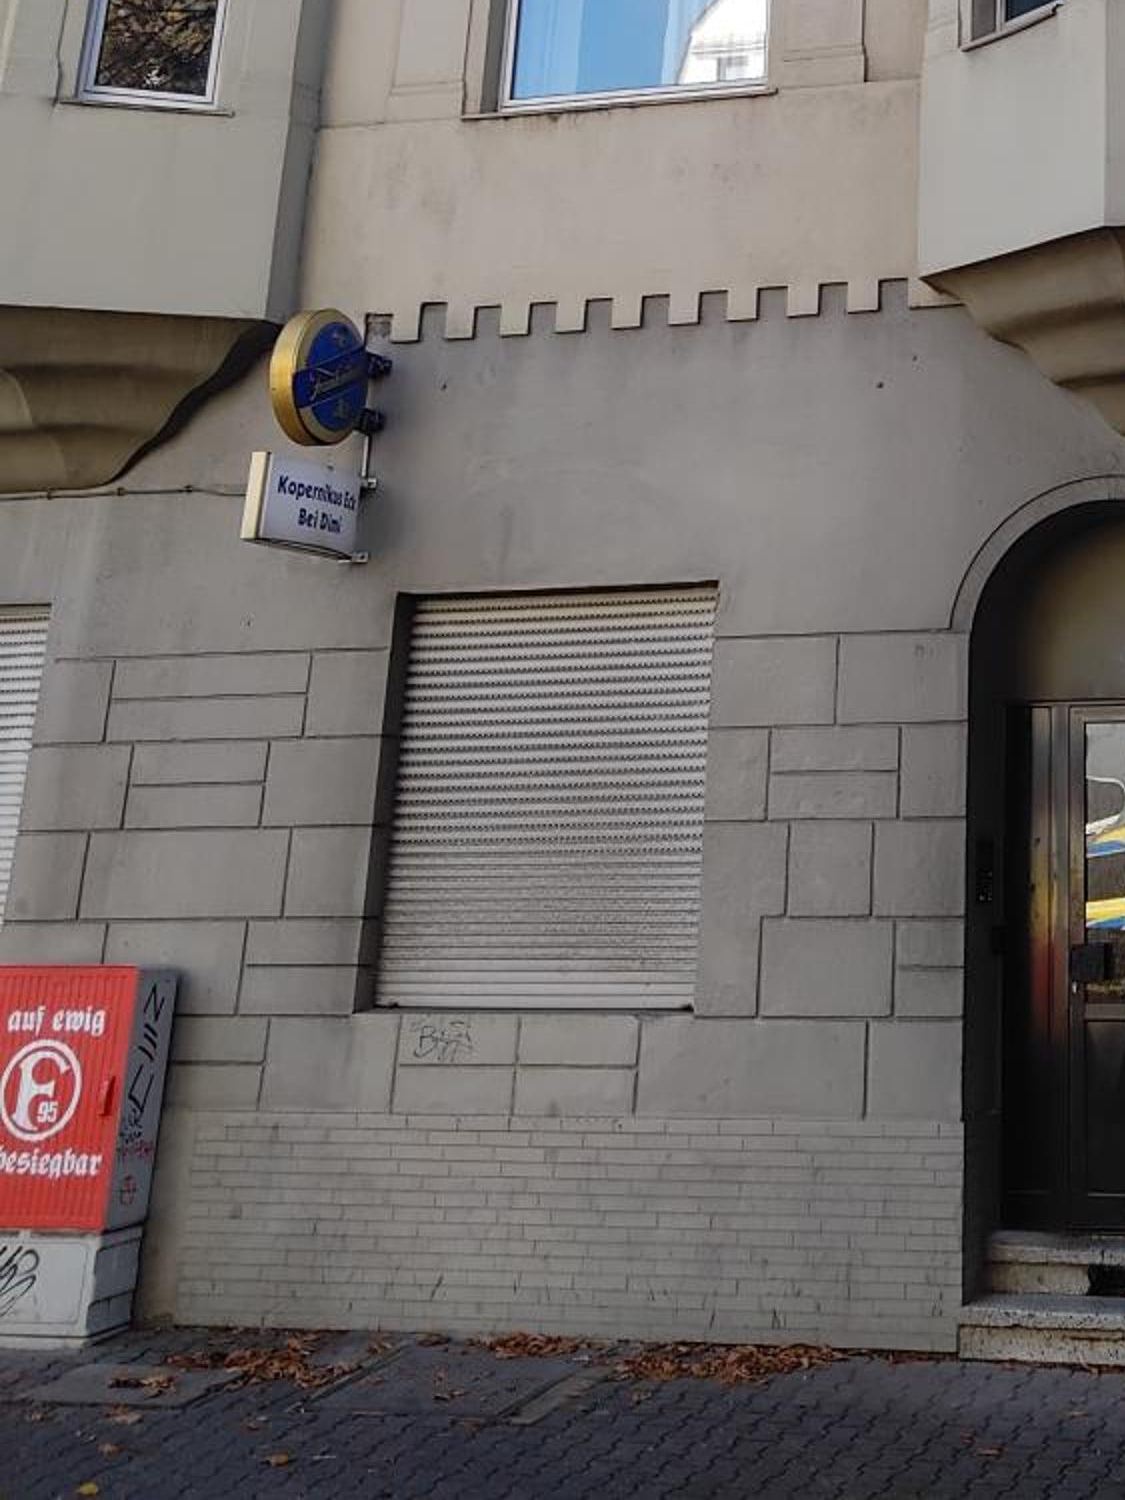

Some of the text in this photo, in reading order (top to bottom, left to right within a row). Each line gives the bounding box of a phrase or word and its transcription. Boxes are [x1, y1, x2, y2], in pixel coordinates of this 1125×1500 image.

[298, 507, 318, 528] Bei
[7, 1005, 107, 1037] auf ewig
